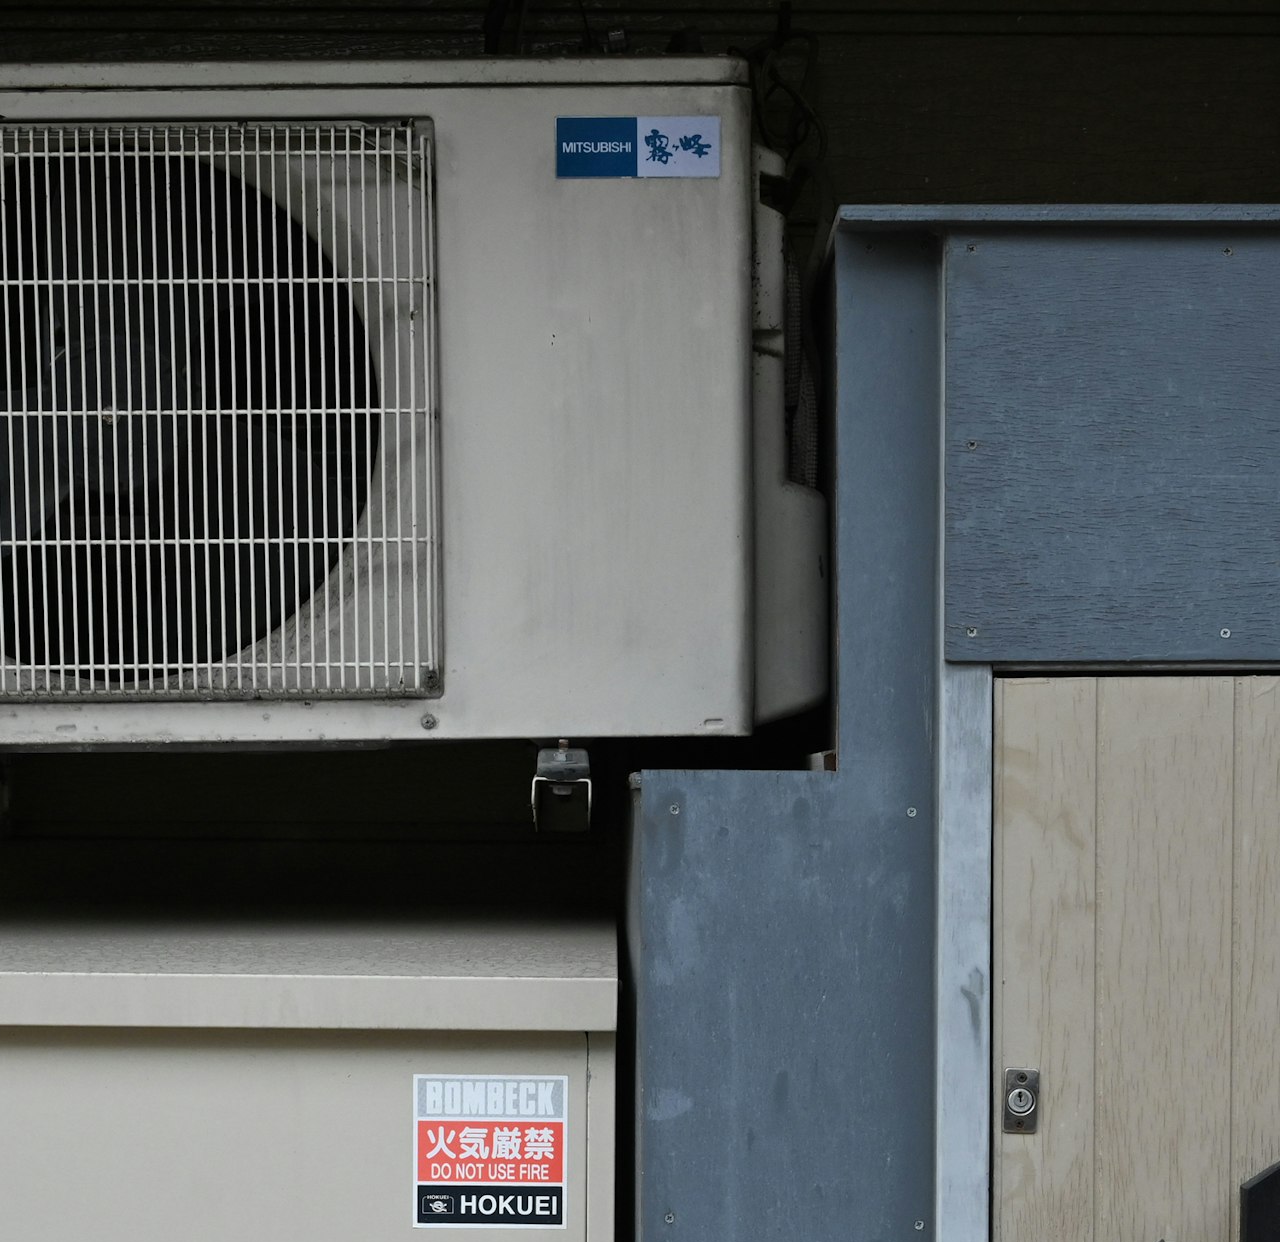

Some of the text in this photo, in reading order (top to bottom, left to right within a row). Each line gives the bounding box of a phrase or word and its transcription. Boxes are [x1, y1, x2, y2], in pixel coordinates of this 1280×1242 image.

[562, 141, 631, 153] MITSUBISHI
[425, 1081, 555, 1116] BOMBECK
[425, 1126, 555, 1160] 火気厳禁
[431, 1163, 550, 1180] DO NOT USE FIRE
[460, 1194, 558, 1216] HOKUEI
